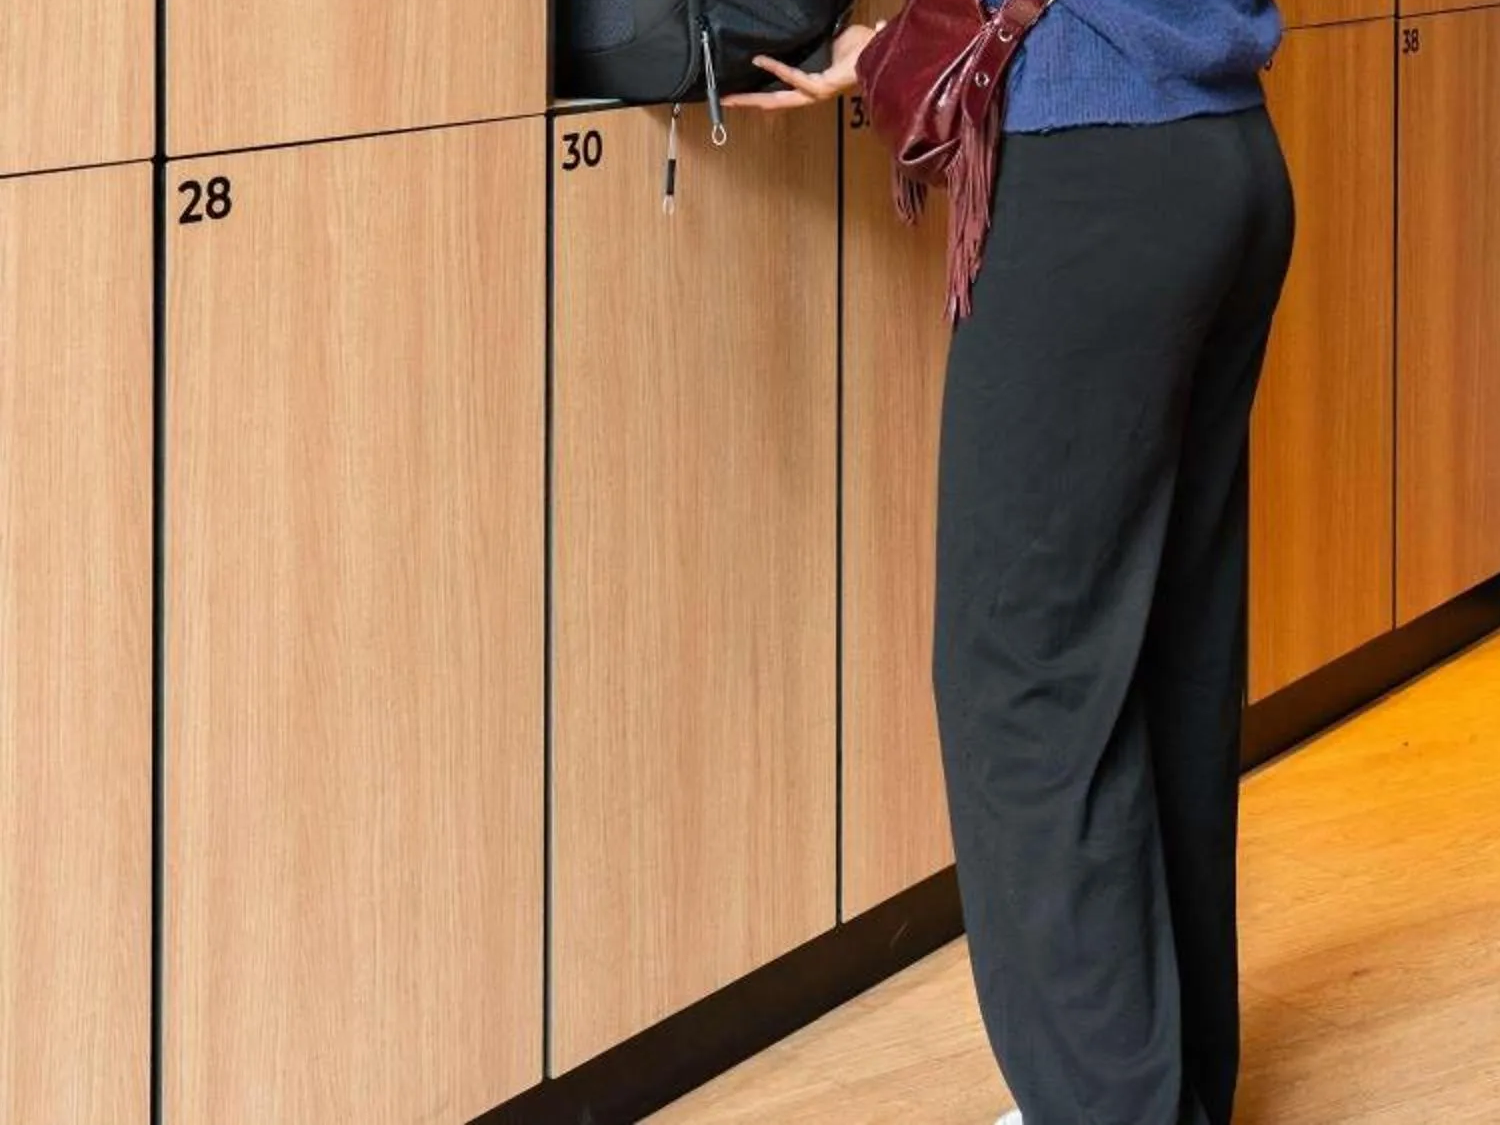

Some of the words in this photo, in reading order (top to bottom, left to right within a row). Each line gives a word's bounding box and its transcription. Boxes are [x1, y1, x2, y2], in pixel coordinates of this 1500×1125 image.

[1403, 29, 1419, 54] 38
[562, 130, 602, 172] 30
[178, 177, 232, 224] 28
